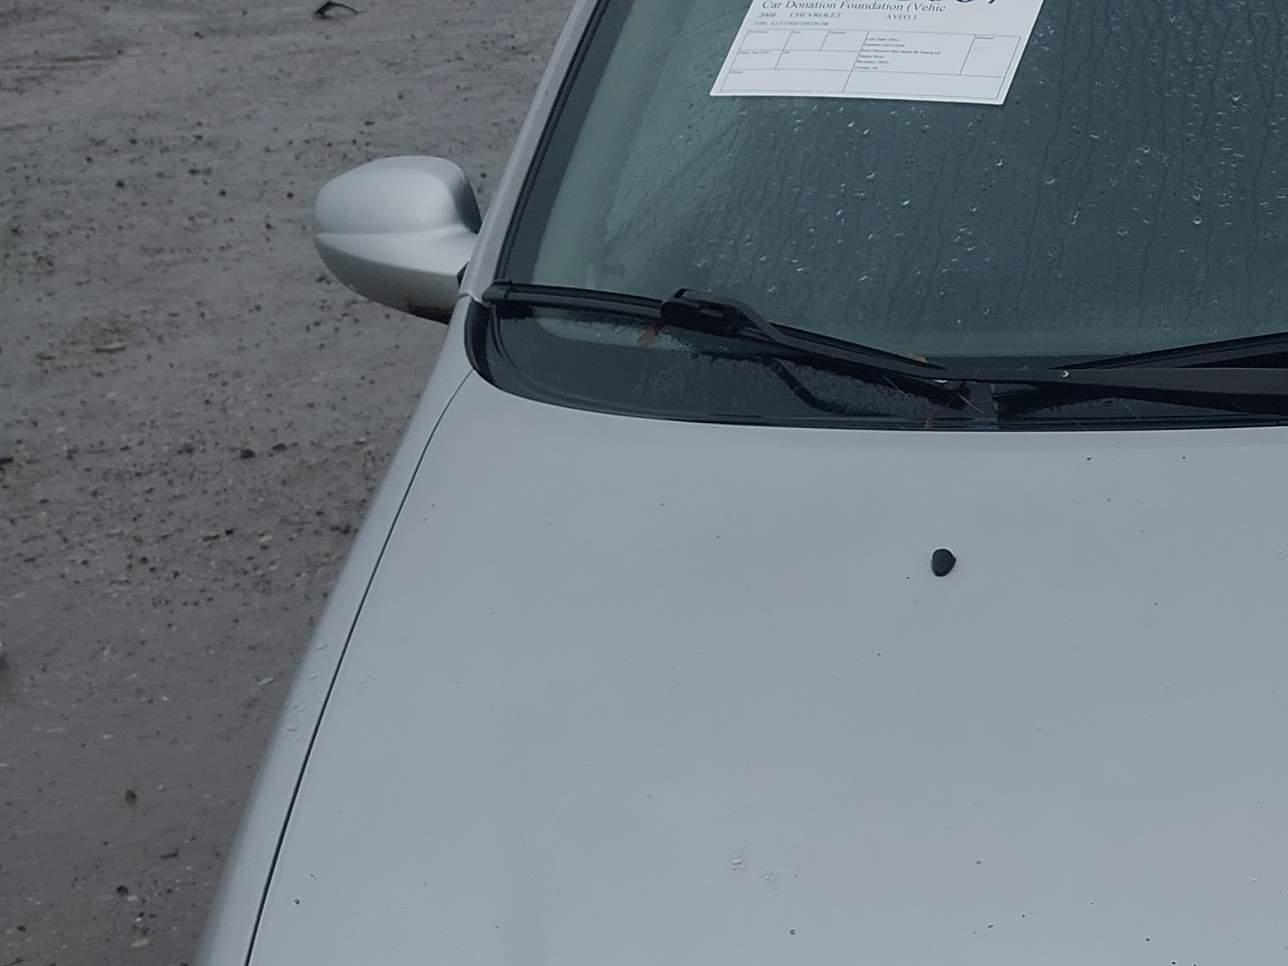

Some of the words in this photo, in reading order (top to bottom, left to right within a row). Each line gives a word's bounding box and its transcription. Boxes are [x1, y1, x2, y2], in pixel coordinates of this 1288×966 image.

[762, 0, 782, 9] Car
[785, 0, 837, 10] Donation
[839, 1, 904, 11] Foundation
[905, 2, 947, 13] (Vehic
